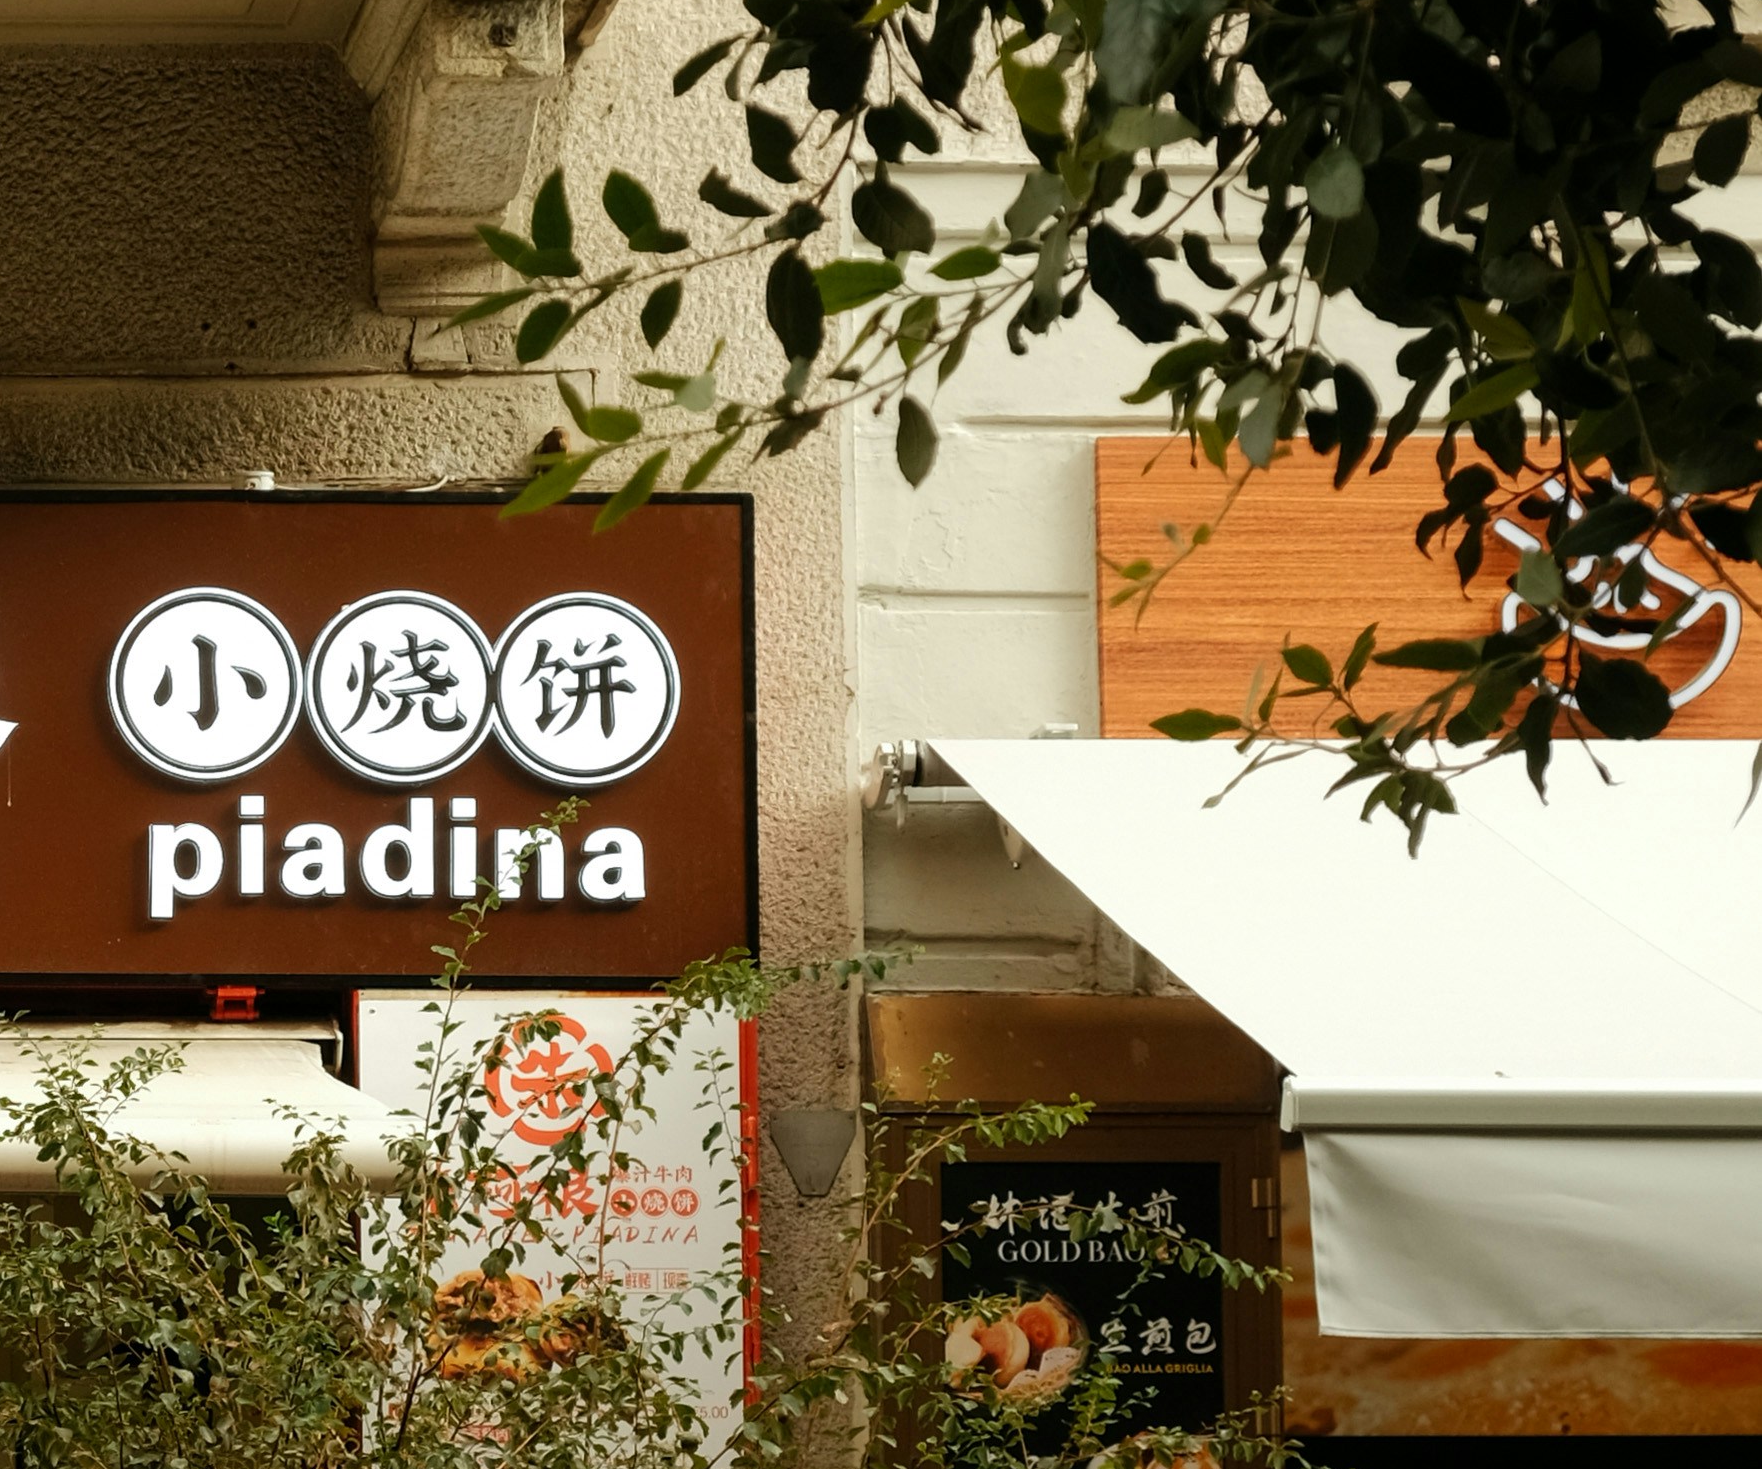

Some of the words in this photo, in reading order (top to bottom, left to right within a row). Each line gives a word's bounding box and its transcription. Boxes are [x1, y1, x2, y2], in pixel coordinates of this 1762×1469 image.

[154, 634, 633, 737] 小烧饼
[148, 795, 646, 919] piadina
[573, 1225, 699, 1244] PIADINA
[997, 1239, 1081, 1263] GOLD
[1133, 1364, 1163, 1374] ALLA
[1164, 1364, 1214, 1374] GRIGLIA
[693, 1405, 729, 1419] 5.00
